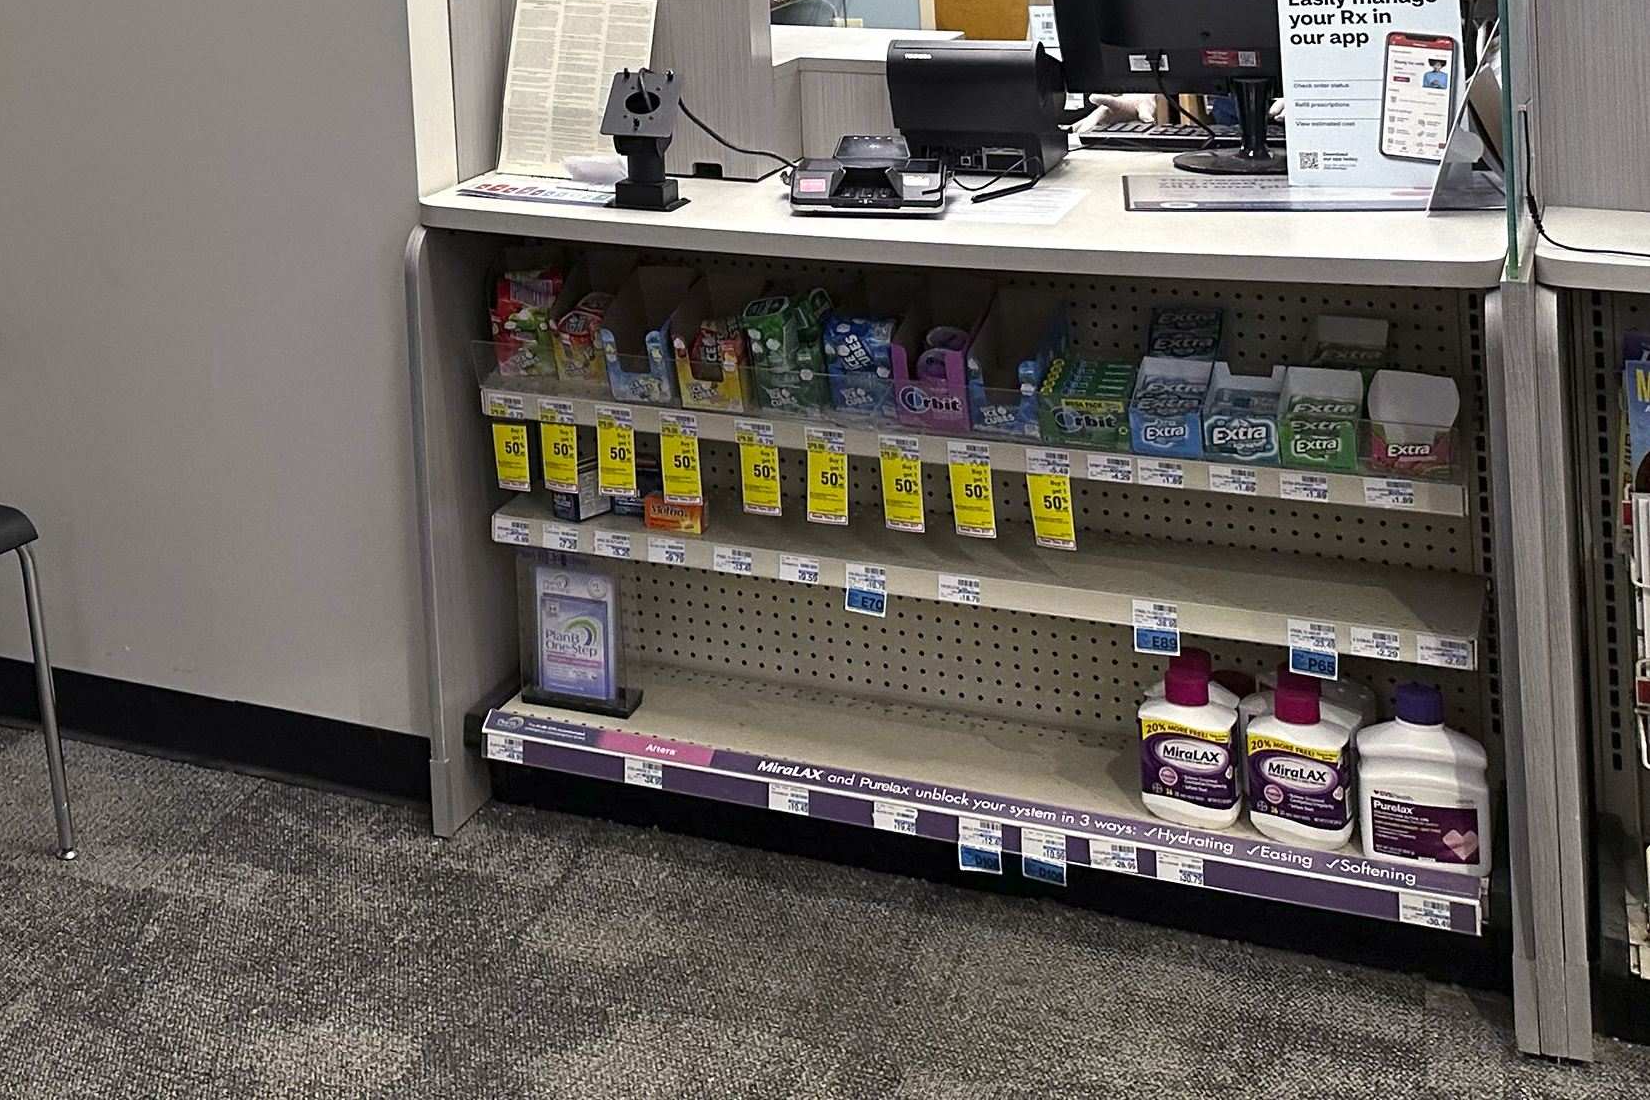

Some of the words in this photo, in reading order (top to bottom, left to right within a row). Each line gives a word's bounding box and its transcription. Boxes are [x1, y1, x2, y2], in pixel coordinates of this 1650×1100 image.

[1288, 12, 1335, 29] your
[1340, 10, 1368, 25] Rx
[1373, 8, 1392, 24] in
[1289, 32, 1325, 46] our
[1329, 31, 1370, 48] app
[1153, 337, 1214, 350] Extra
[899, 385, 962, 414] Orbit
[1292, 402, 1356, 414] Extra
[1051, 406, 1117, 433] Orbit
[1145, 425, 1186, 441] Extra
[1212, 423, 1267, 445] Extra
[1295, 437, 1339, 453] Extra
[1387, 443, 1431, 458] Extra
[861, 596, 884, 610] E70
[545, 640, 598, 658] One-Step
[1152, 635, 1178, 650] E89
[1308, 657, 1336, 673] P65
[1145, 723, 1167, 734] 20%
[1250, 739, 1272, 750] 20%
[1162, 744, 1221, 763] MiraLAX
[1267, 762, 1329, 783] MiraLAX
[1373, 800, 1414, 815] Purelax
[756, 759, 825, 782] MiraLAX
[827, 771, 855, 786] and
[858, 777, 910, 796] Purelax
[914, 785, 970, 807] unblock
[971, 796, 1007, 813] your
[1008, 803, 1057, 823] system
[1061, 811, 1076, 825] in
[1079, 814, 1090, 828] 3
[1094, 818, 1138, 837] ways:
[1156, 827, 1235, 856] Hydrating
[1259, 845, 1314, 870] Easing
[1339, 858, 1418, 887] Softening
